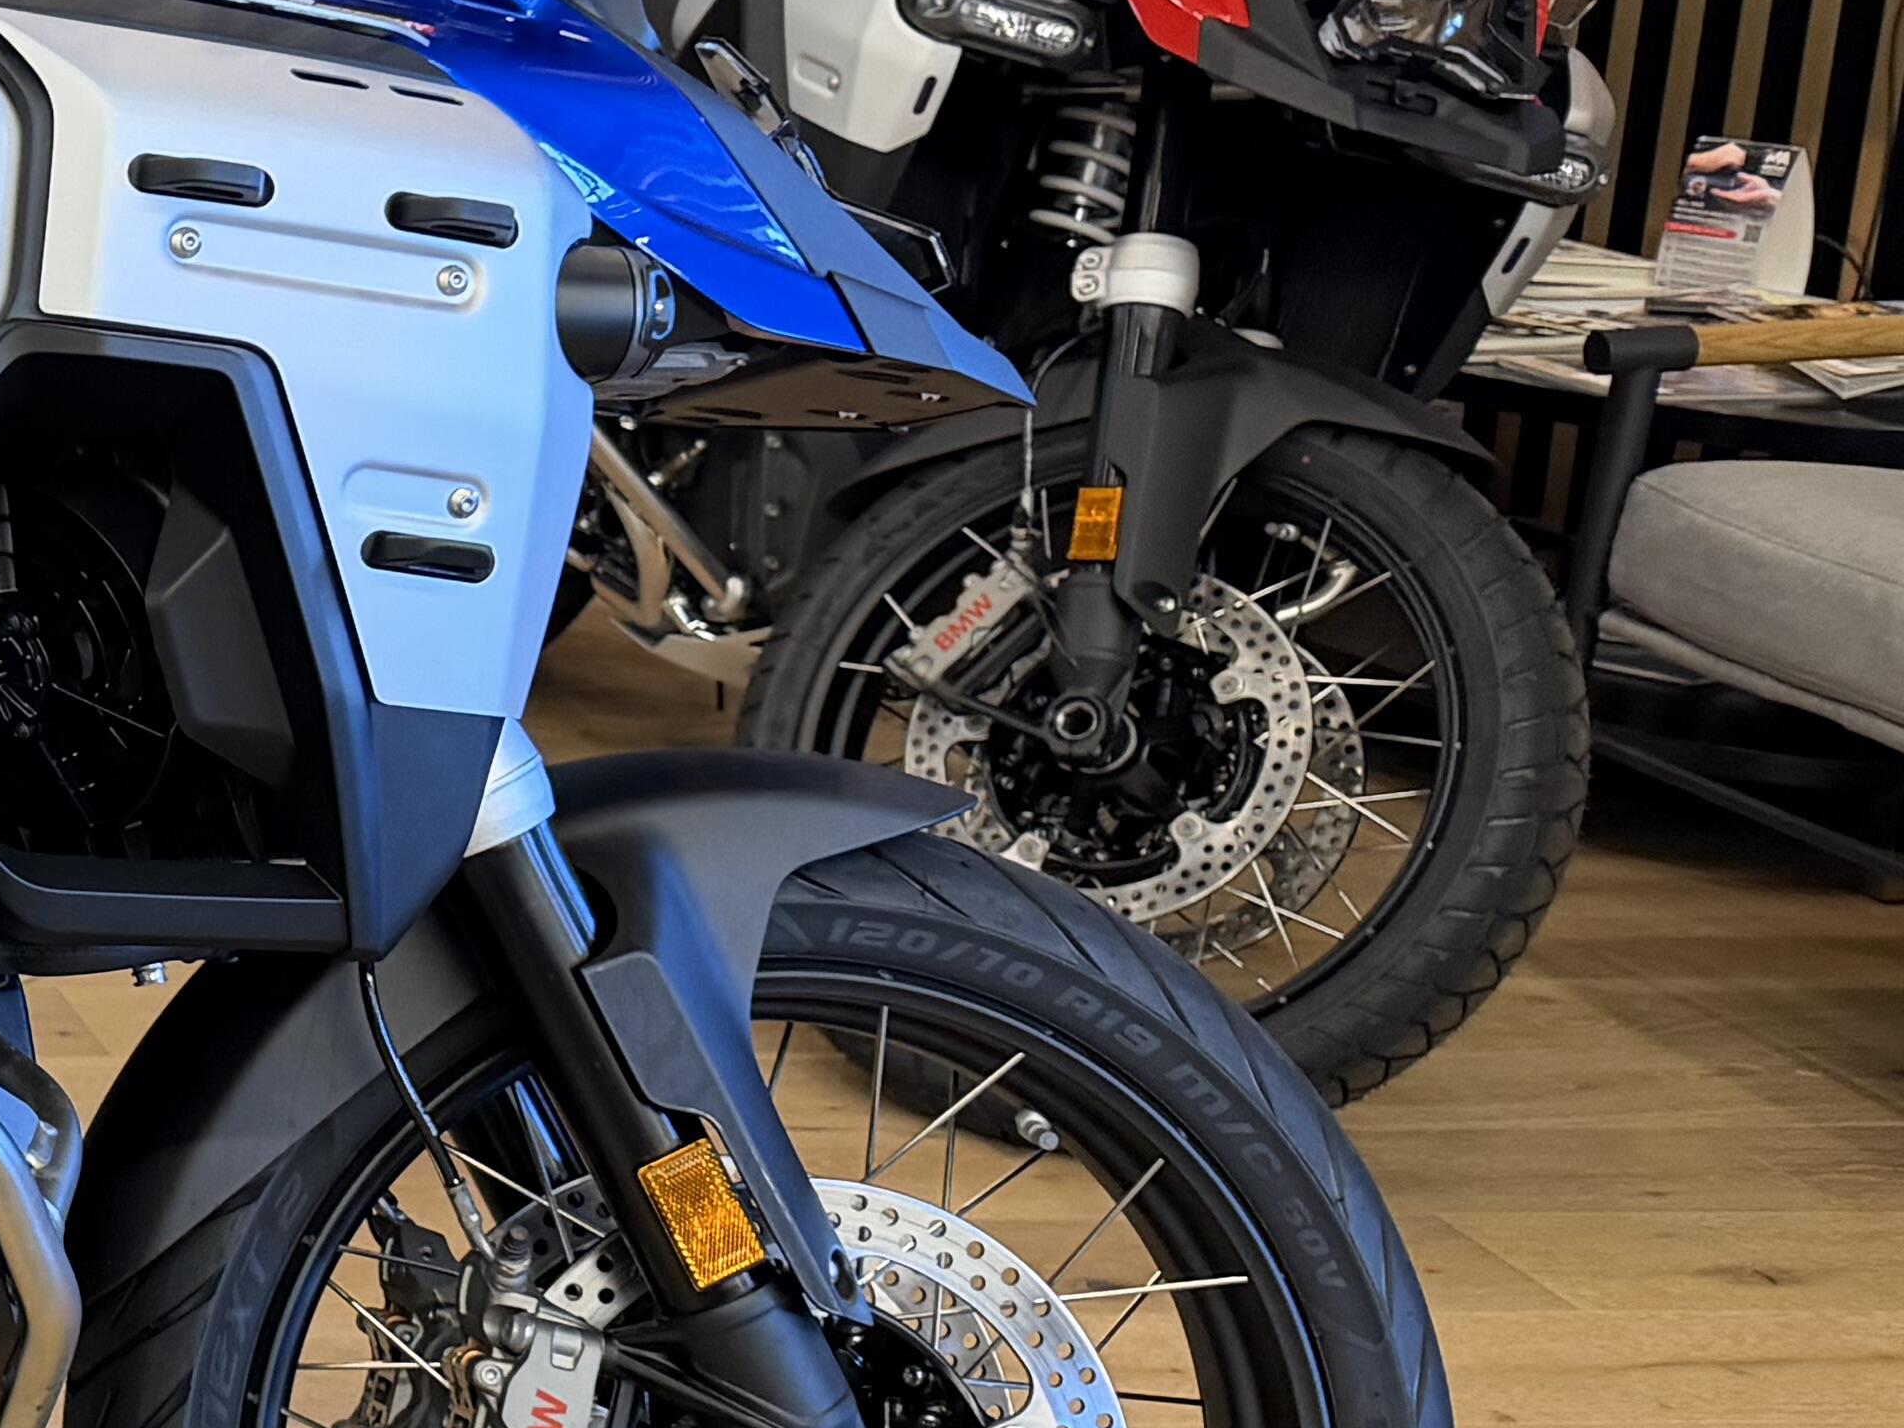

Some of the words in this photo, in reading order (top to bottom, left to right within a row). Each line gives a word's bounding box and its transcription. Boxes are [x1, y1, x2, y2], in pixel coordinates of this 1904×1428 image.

[933, 593, 993, 653] BMW
[827, 916, 1045, 990] 120/70
[1053, 986, 1163, 1058] R19
[1168, 1066, 1283, 1175] M/C
[1286, 1195, 1348, 1291] 60V
